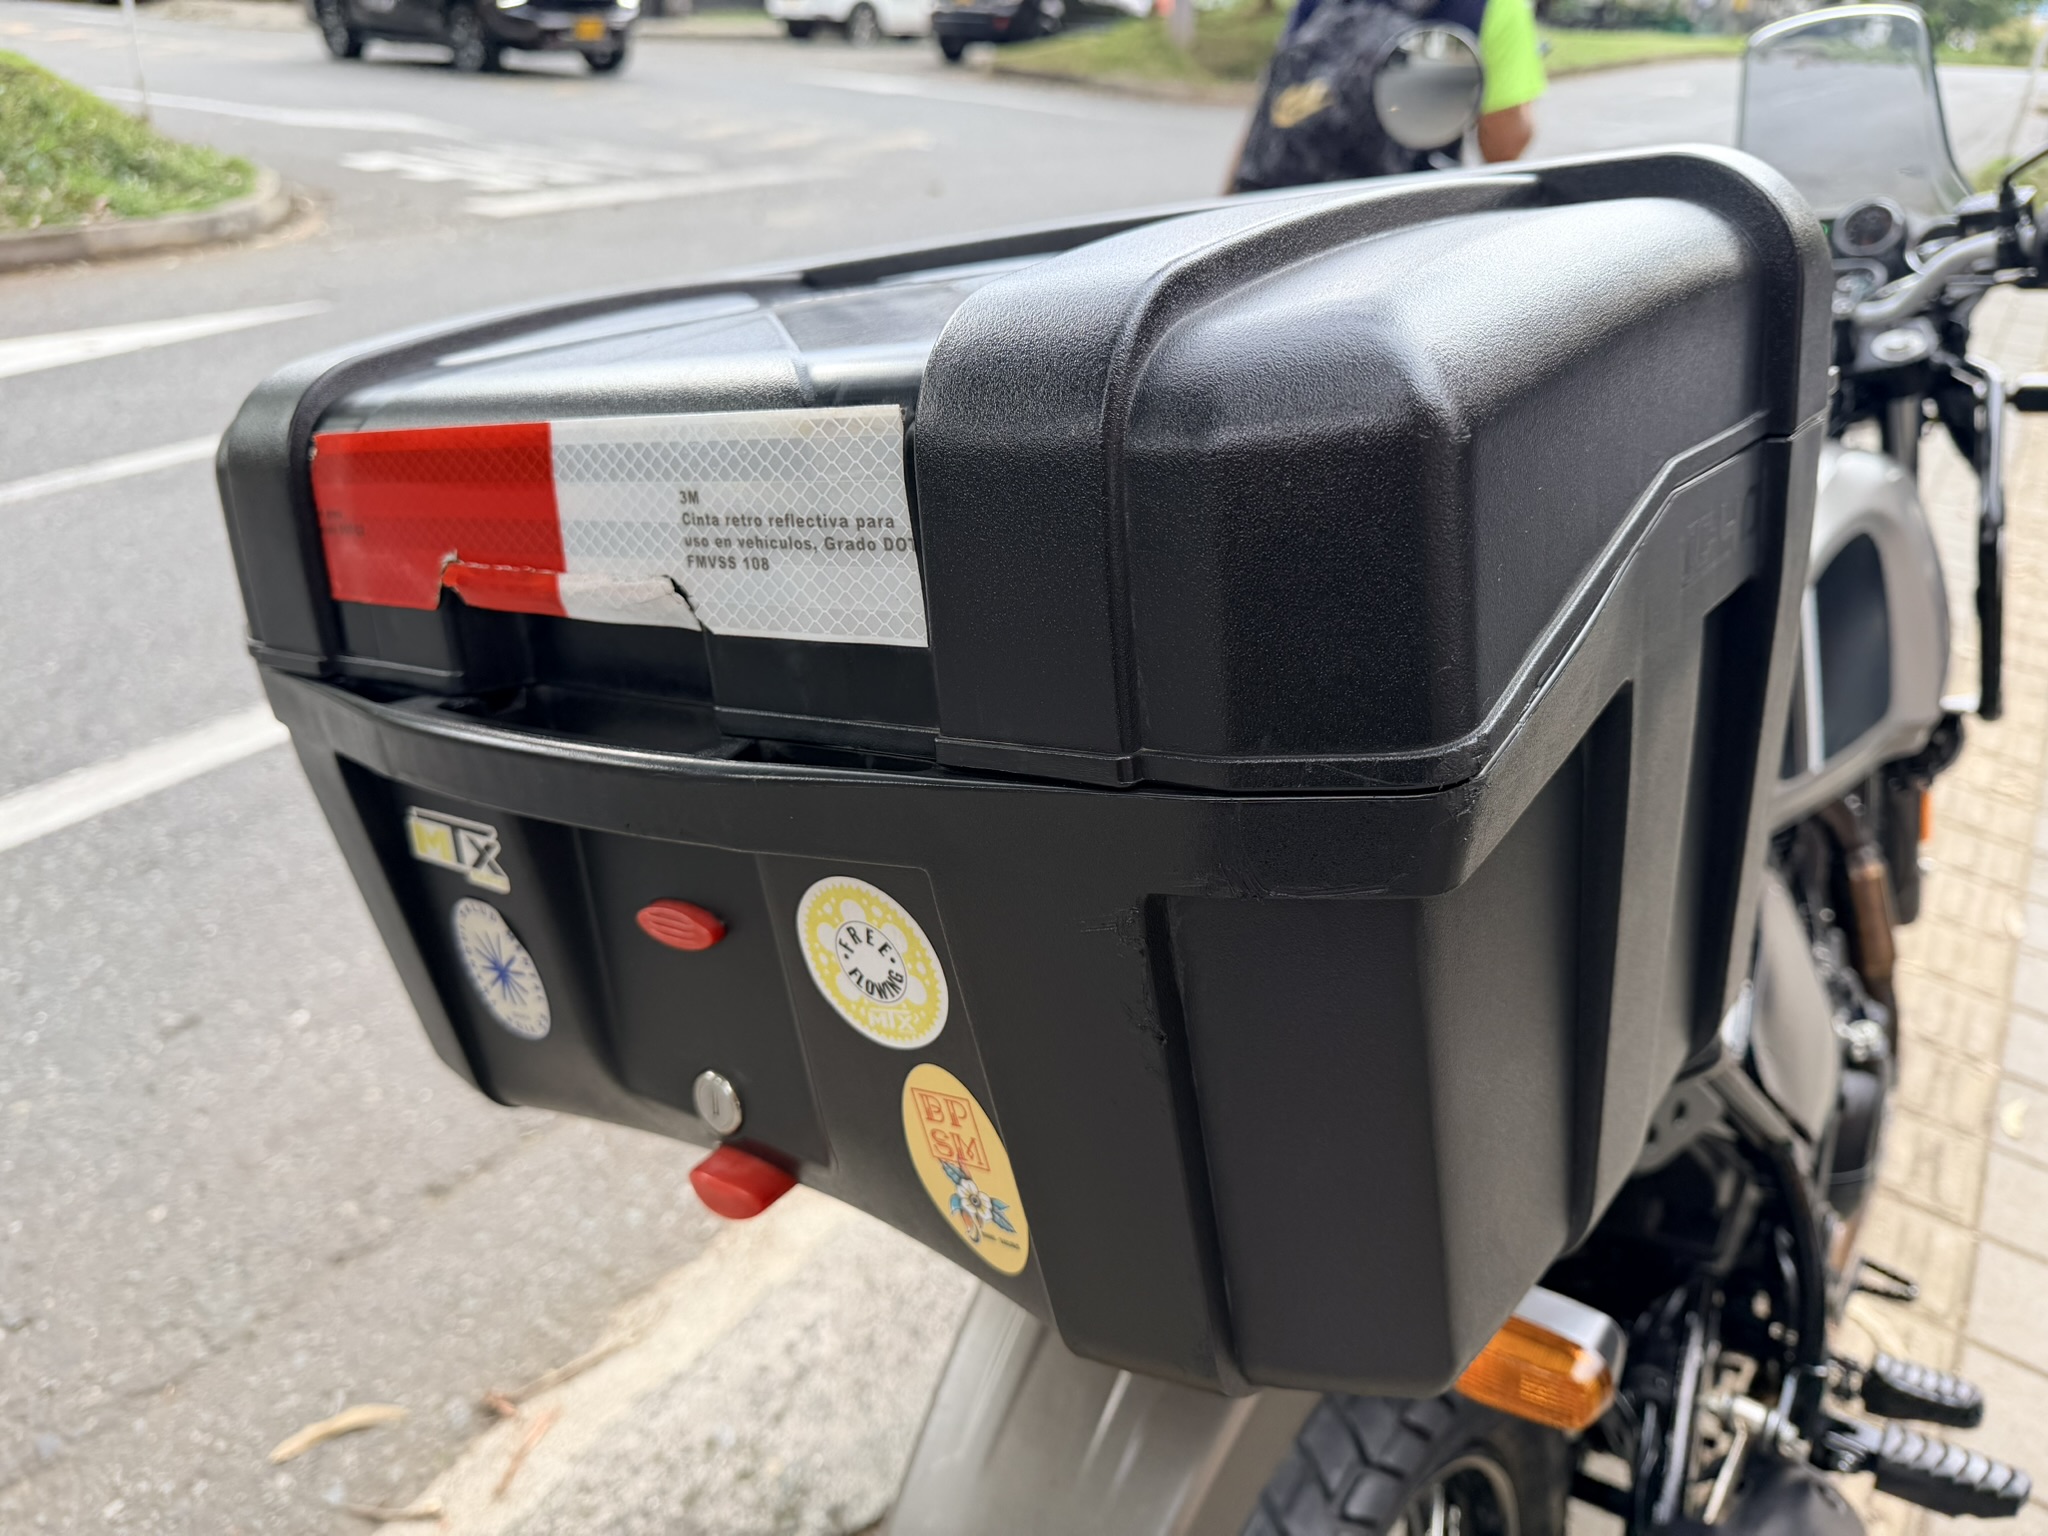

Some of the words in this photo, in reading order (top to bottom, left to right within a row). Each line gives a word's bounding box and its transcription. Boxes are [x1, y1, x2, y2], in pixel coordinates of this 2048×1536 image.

[679, 490, 700, 504] 3M
[682, 512, 720, 526] Cinta
[725, 514, 763, 527] retro
[768, 513, 849, 528] reflectiva
[856, 516, 895, 531] para
[685, 537, 710, 548] uso
[715, 537, 732, 548] en
[824, 536, 877, 551] Grado
[687, 555, 737, 570] FMVSS
[743, 557, 770, 571] 108
[848, 966, 905, 1000] FLOWING
[918, 1093, 967, 1128] BP
